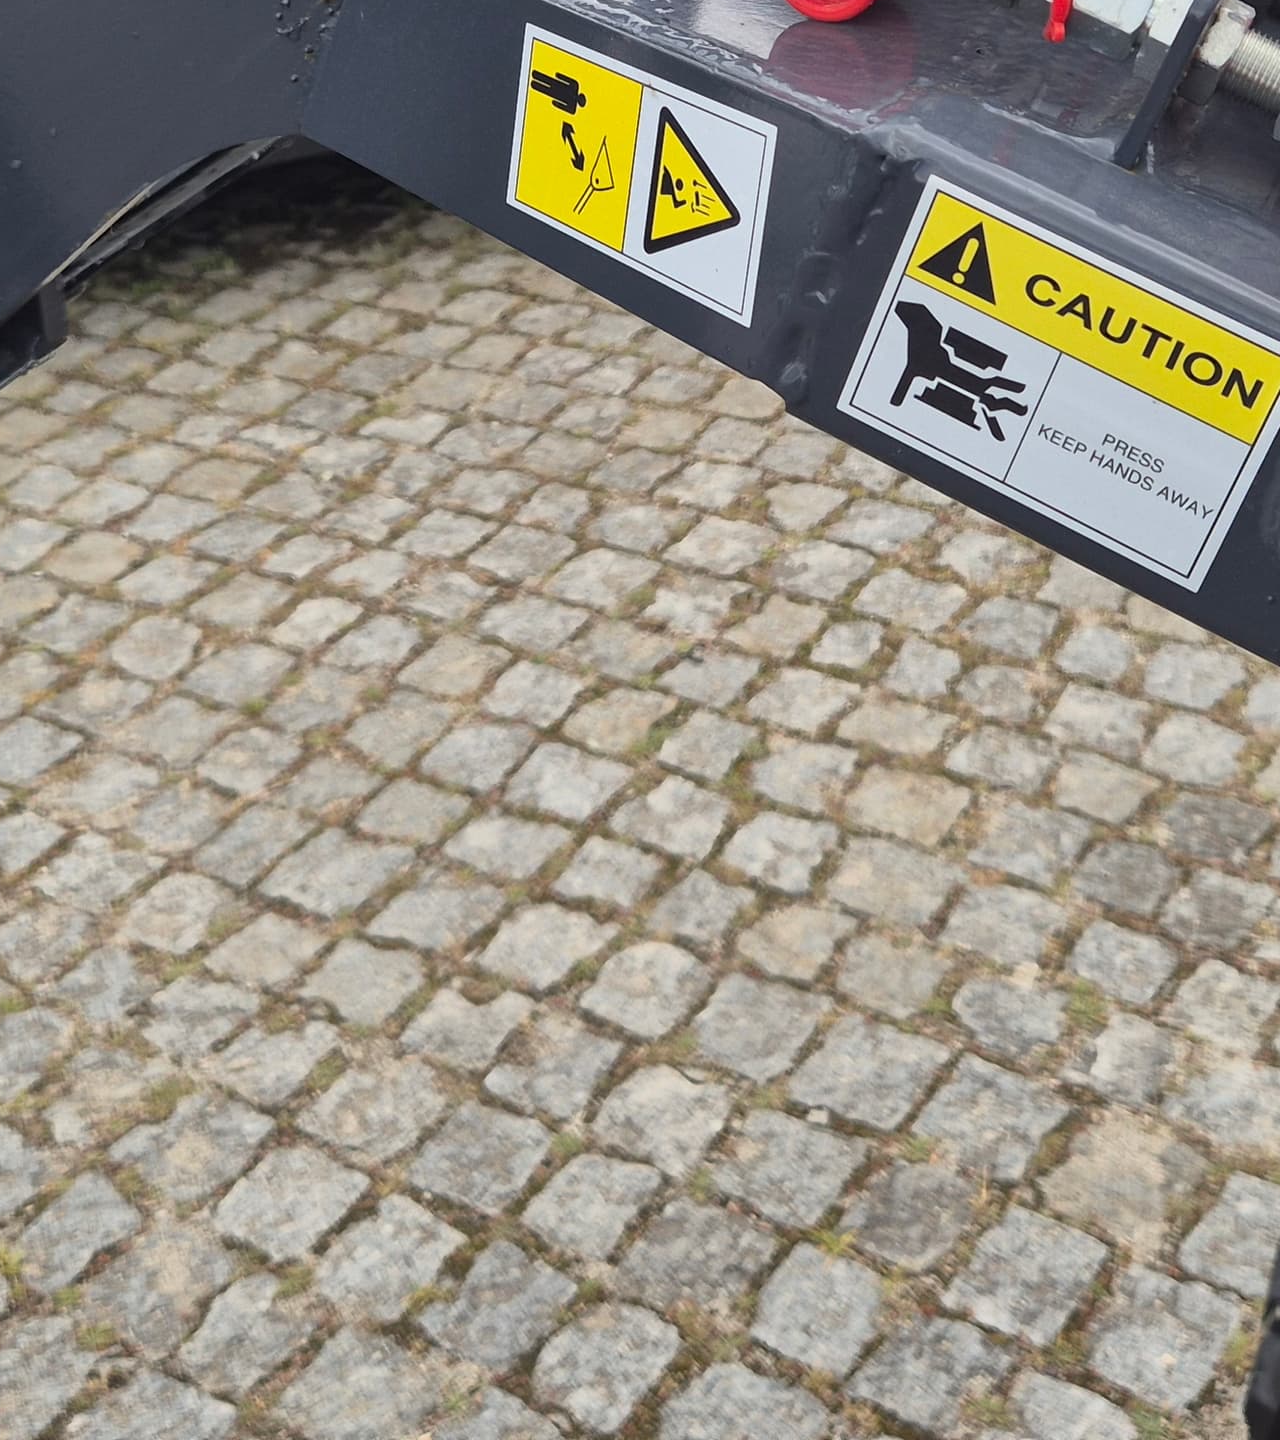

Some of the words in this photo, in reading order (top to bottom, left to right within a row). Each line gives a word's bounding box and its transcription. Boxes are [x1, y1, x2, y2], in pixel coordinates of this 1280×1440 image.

[1024, 273, 1265, 409] CAUTION
[1037, 423, 1088, 456] KEEP
[1088, 449, 1155, 492] HANDS
[1156, 486, 1214, 520] AWAY
[1101, 433, 1166, 474] PRESS
